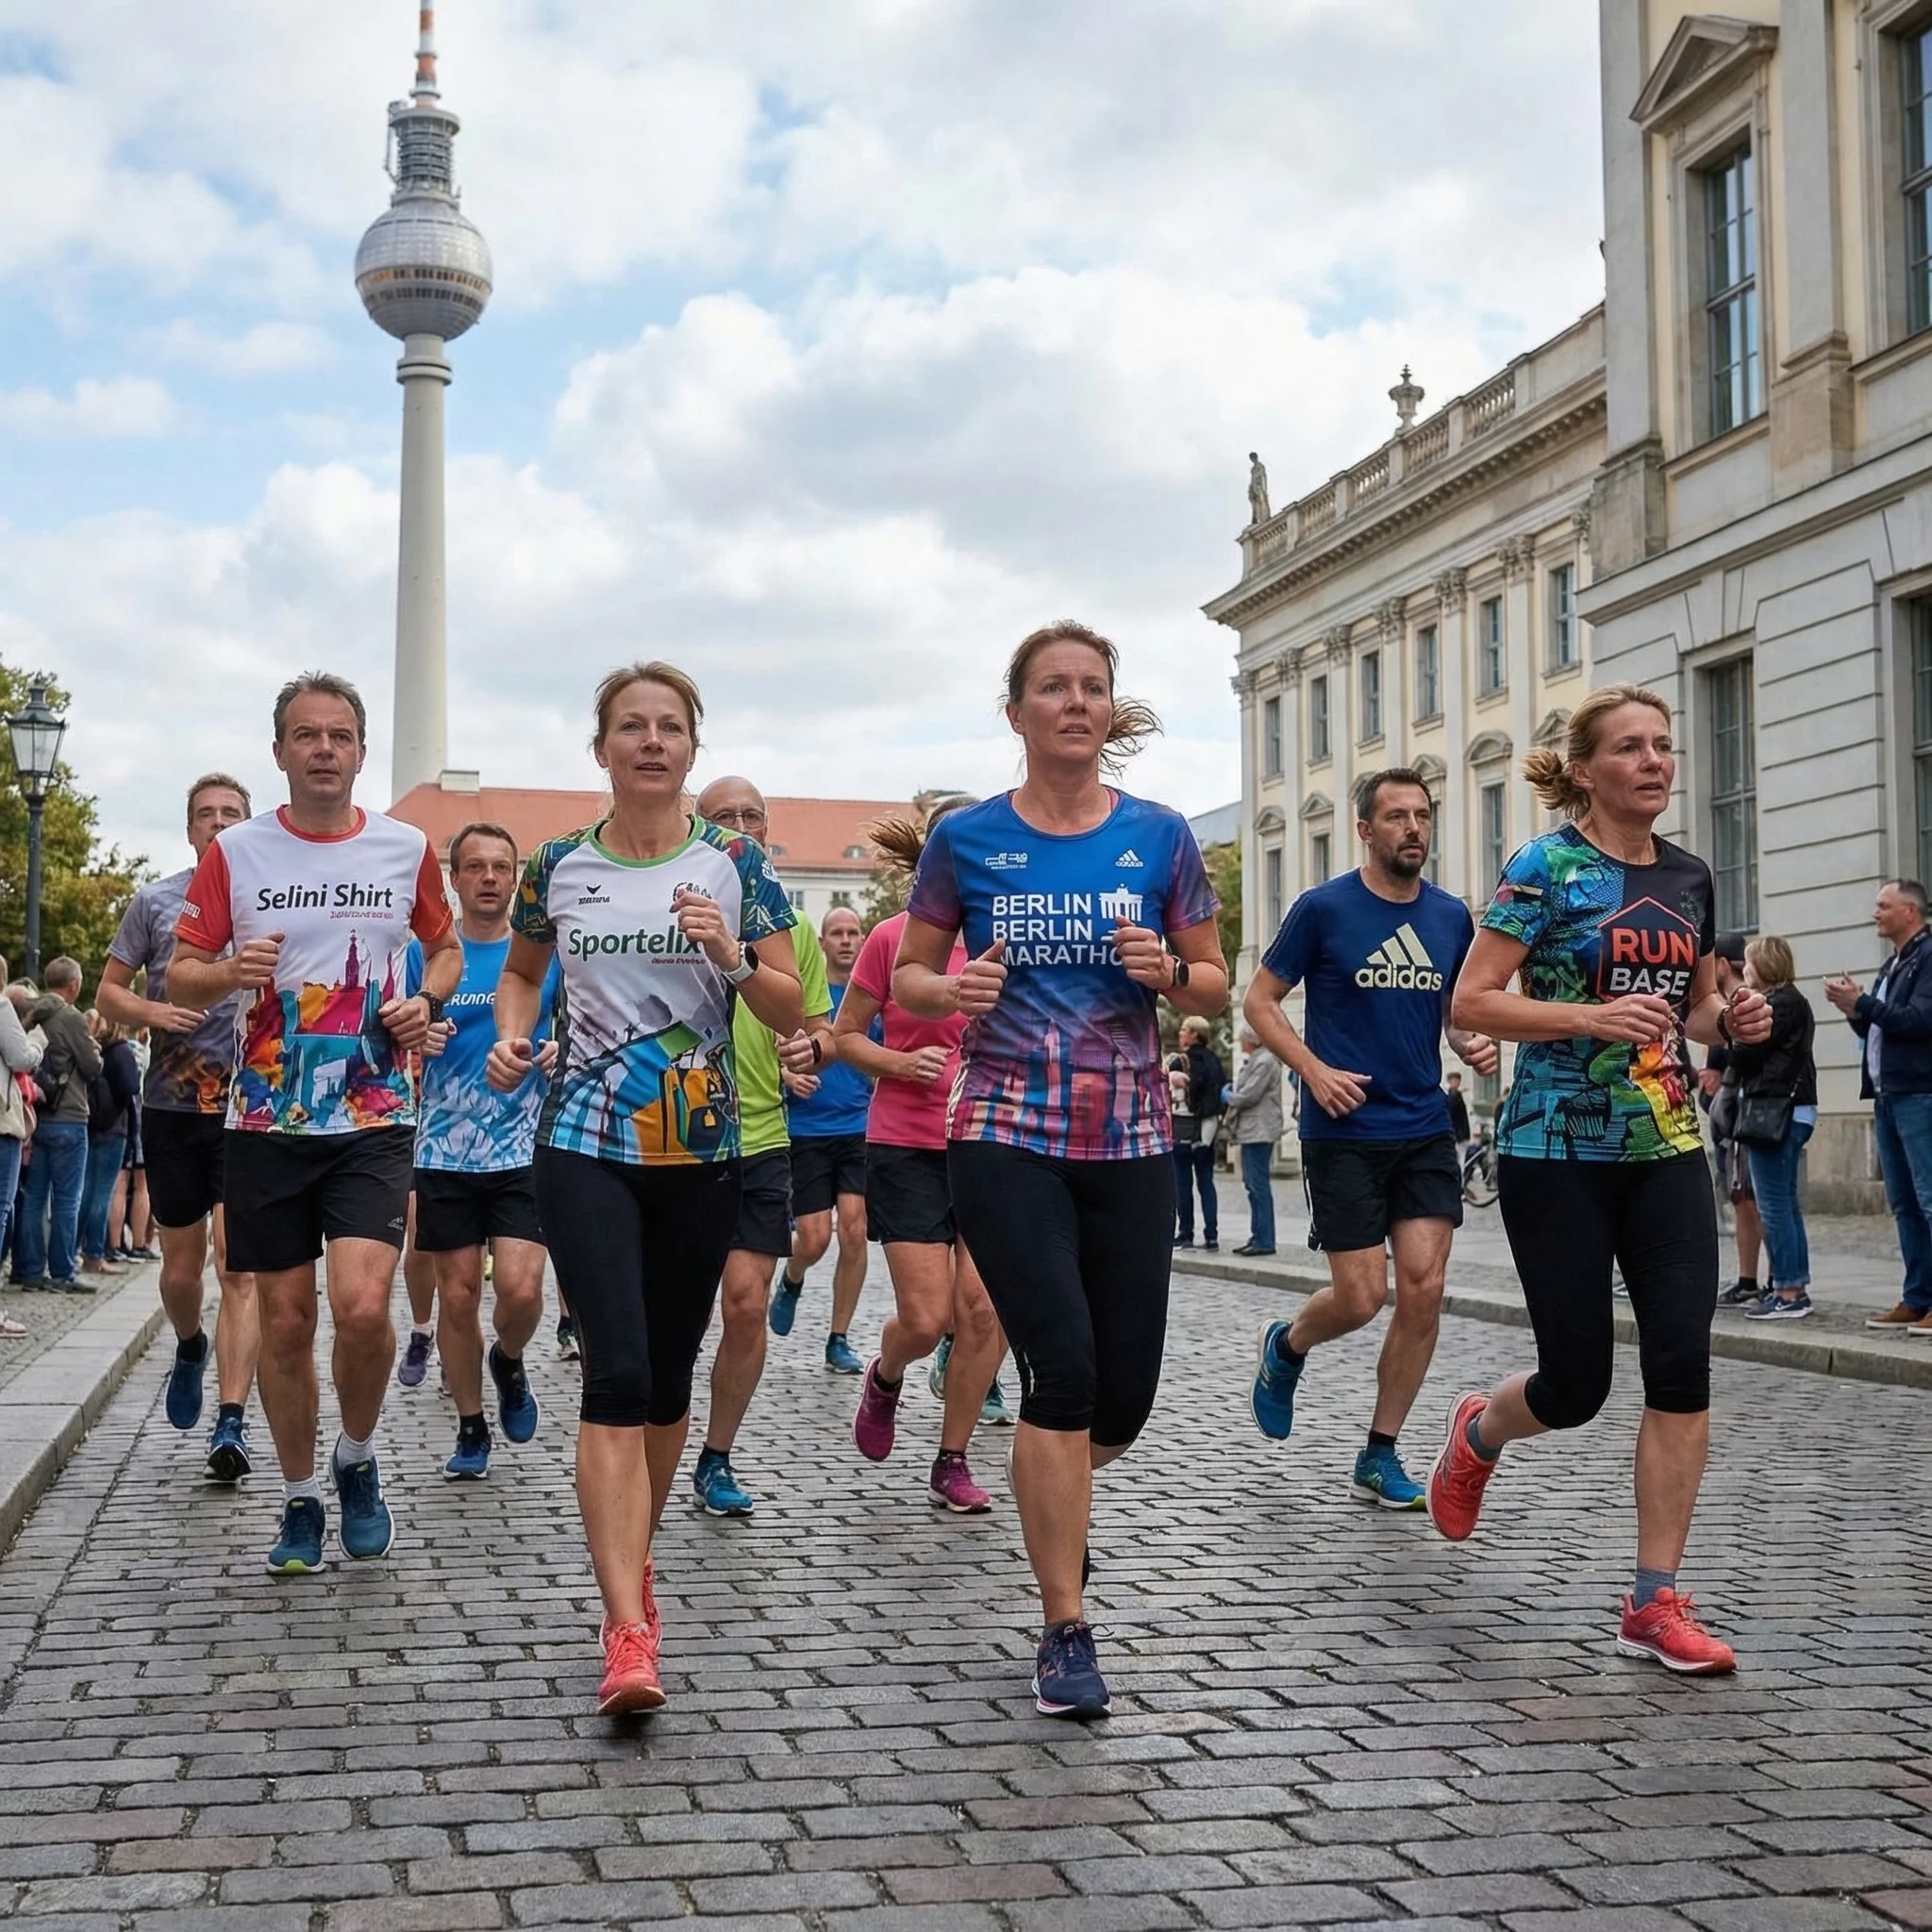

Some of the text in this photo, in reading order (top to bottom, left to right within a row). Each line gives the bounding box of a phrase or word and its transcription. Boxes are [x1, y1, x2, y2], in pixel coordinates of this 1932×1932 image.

[256, 882, 393, 911] Selini Shirt
[992, 893, 1091, 917] BERLIN
[992, 919, 1092, 942] BERLIN
[1612, 927, 1694, 967] RUN
[1355, 962, 1443, 991] adidas
[1609, 967, 1690, 995] BASE
